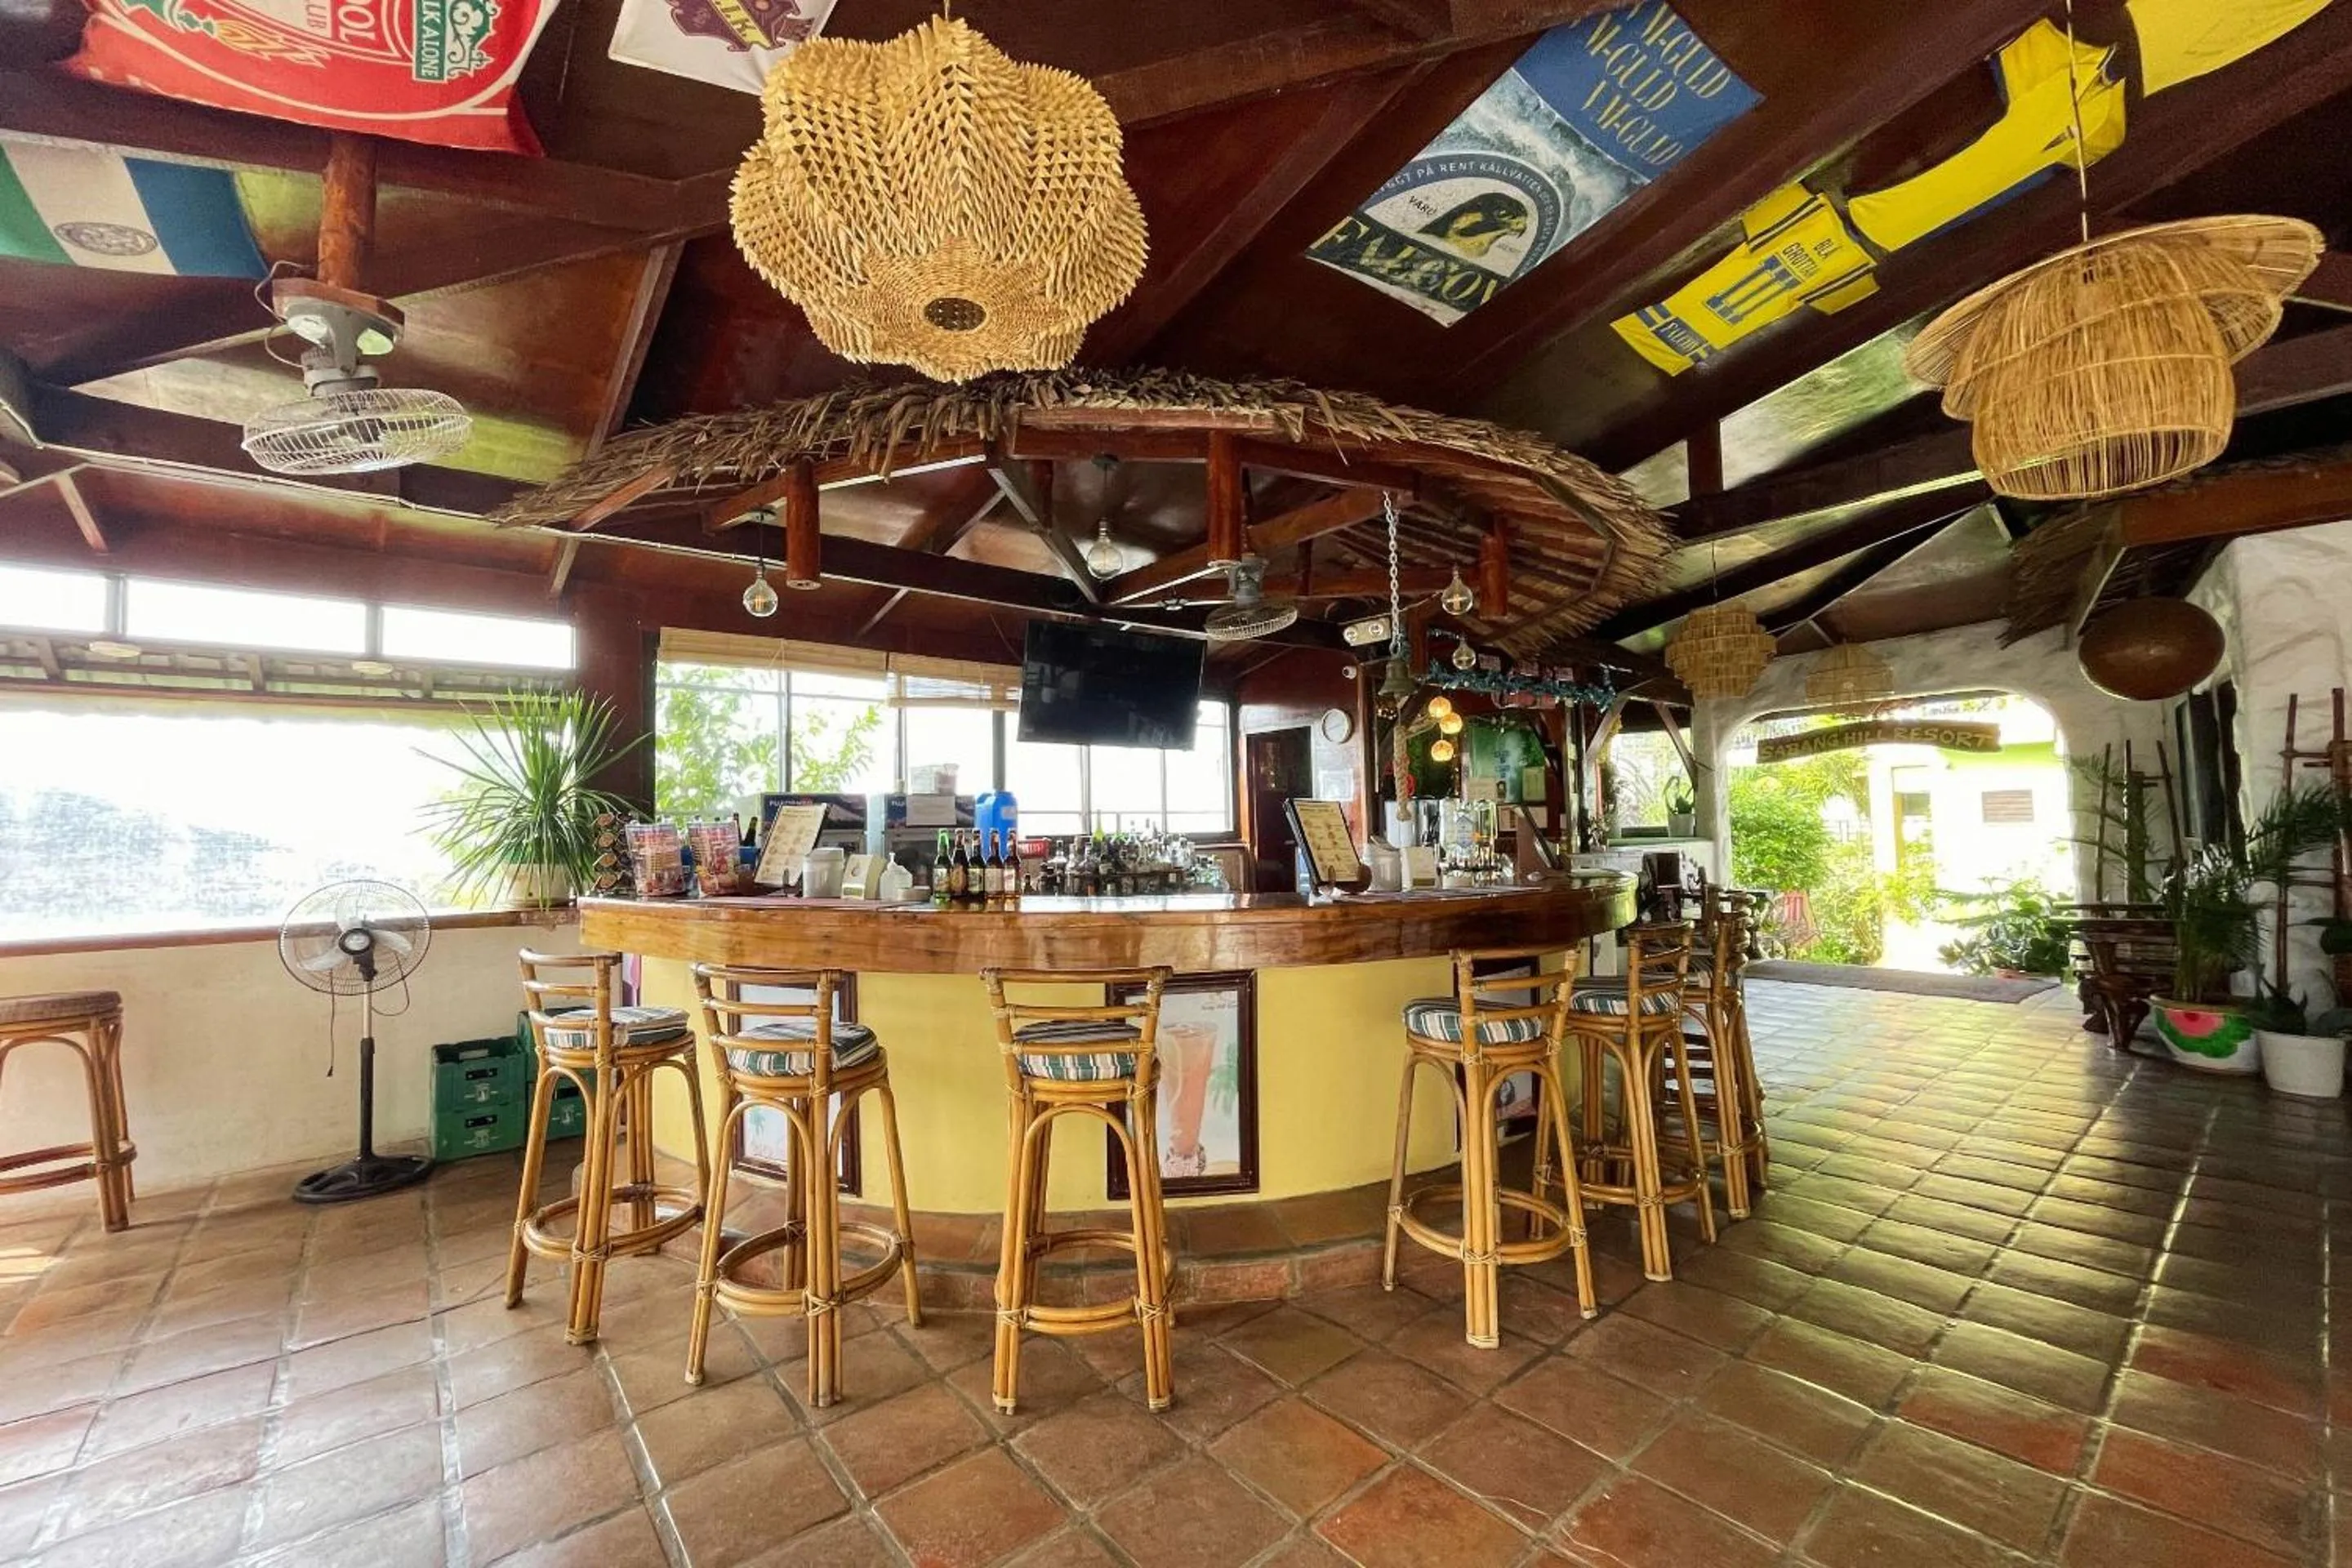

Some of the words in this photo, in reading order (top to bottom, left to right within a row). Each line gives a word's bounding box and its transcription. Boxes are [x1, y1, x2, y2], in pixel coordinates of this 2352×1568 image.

[305, 0, 327, 29] UB
[338, 0, 376, 42] OL
[421, 25, 440, 78] ALONE
[1438, 162, 1474, 172] RENT
[1762, 734, 1838, 760] SABANG
[1845, 729, 1887, 745] HILL
[1893, 727, 1994, 748] RESORT
